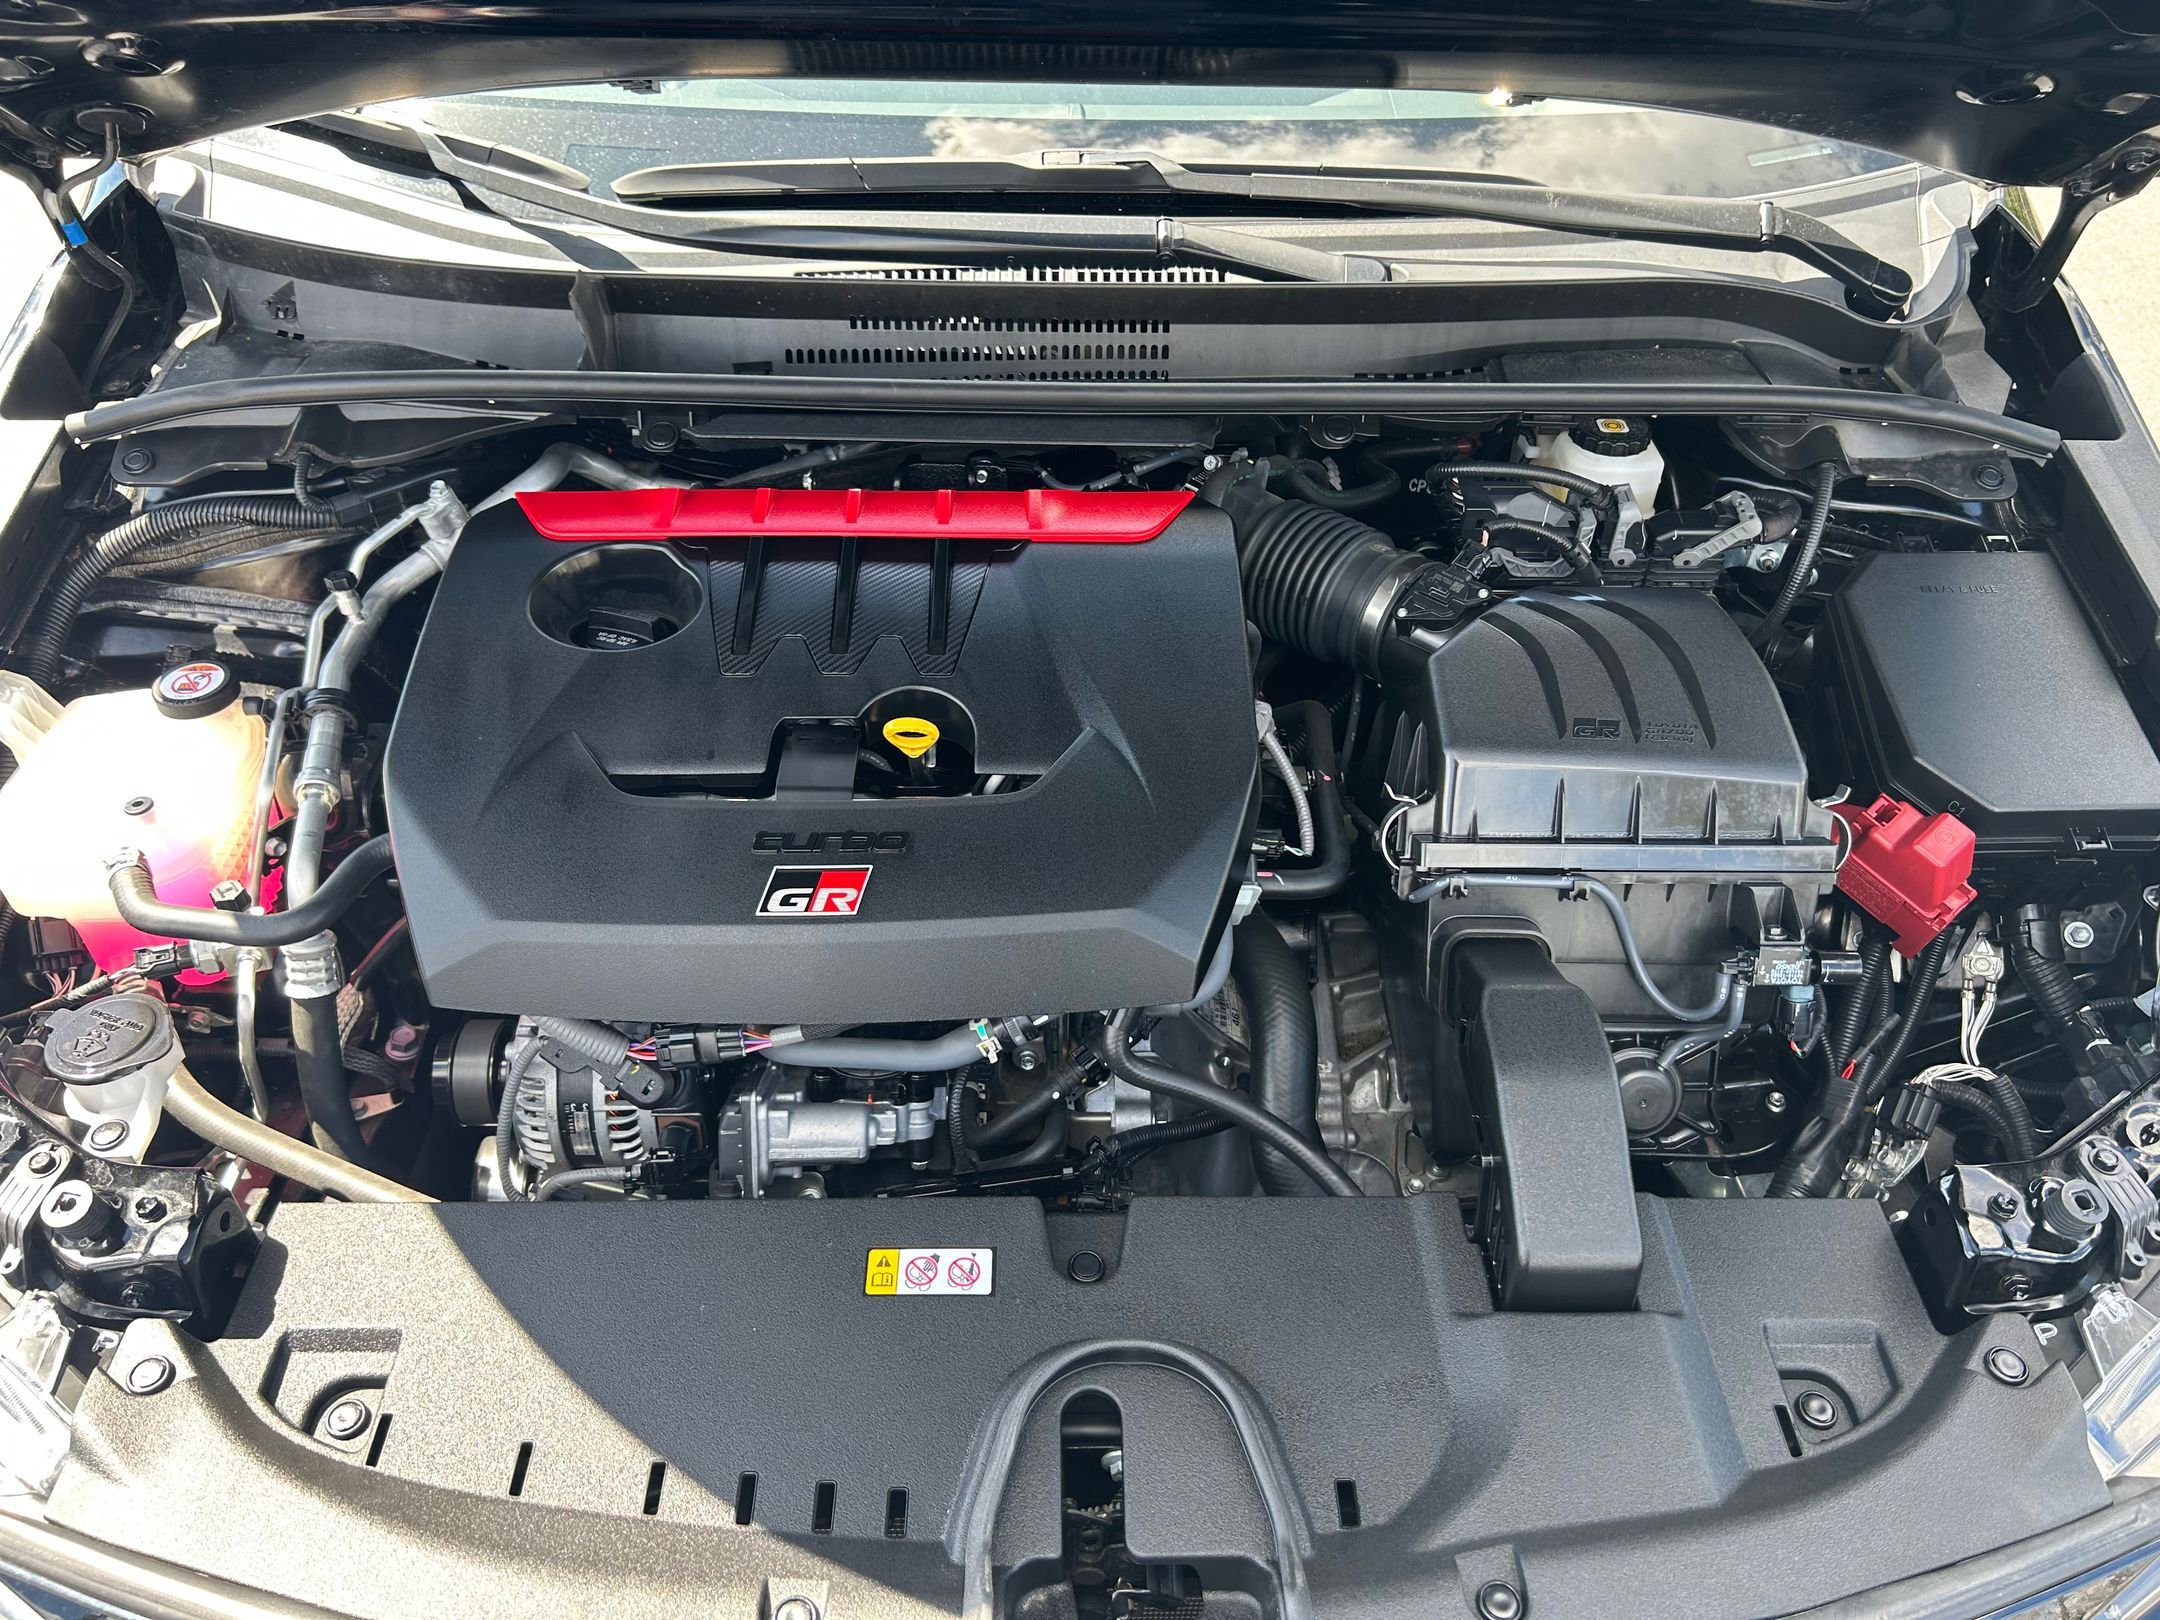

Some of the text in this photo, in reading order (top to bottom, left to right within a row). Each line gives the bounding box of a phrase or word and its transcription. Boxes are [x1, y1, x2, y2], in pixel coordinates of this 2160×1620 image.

[1968, 584, 1999, 593] FUSE
[1647, 721, 1698, 730] TOYOTA
[1645, 727, 1694, 736] GAZOO
[1645, 734, 1695, 743] Racing
[752, 829, 910, 854] turbo
[767, 887, 858, 912] GR
[1771, 977, 1803, 985] TOYOTA
